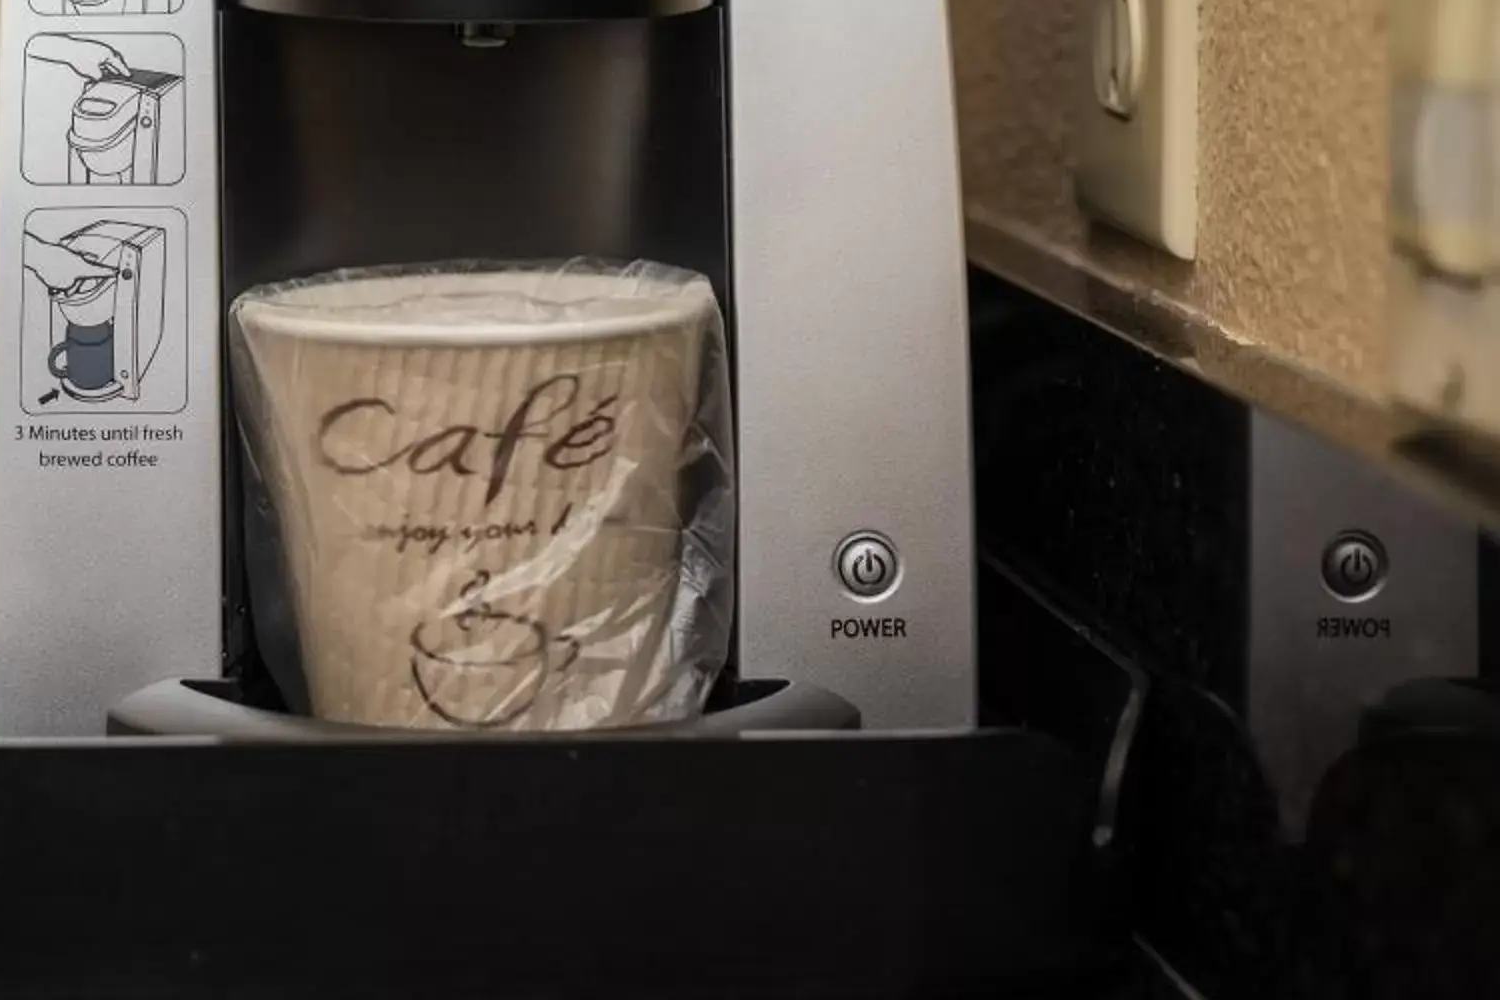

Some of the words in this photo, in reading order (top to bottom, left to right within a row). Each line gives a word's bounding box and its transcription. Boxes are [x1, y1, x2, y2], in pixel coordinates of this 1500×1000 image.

[14, 425, 24, 441] 3
[29, 425, 96, 441] Minutes
[101, 425, 138, 441] until
[143, 424, 183, 441] fresh
[317, 374, 618, 507] Café
[39, 451, 102, 467] brewed
[107, 450, 158, 467] coffee
[831, 618, 907, 638] POWER
